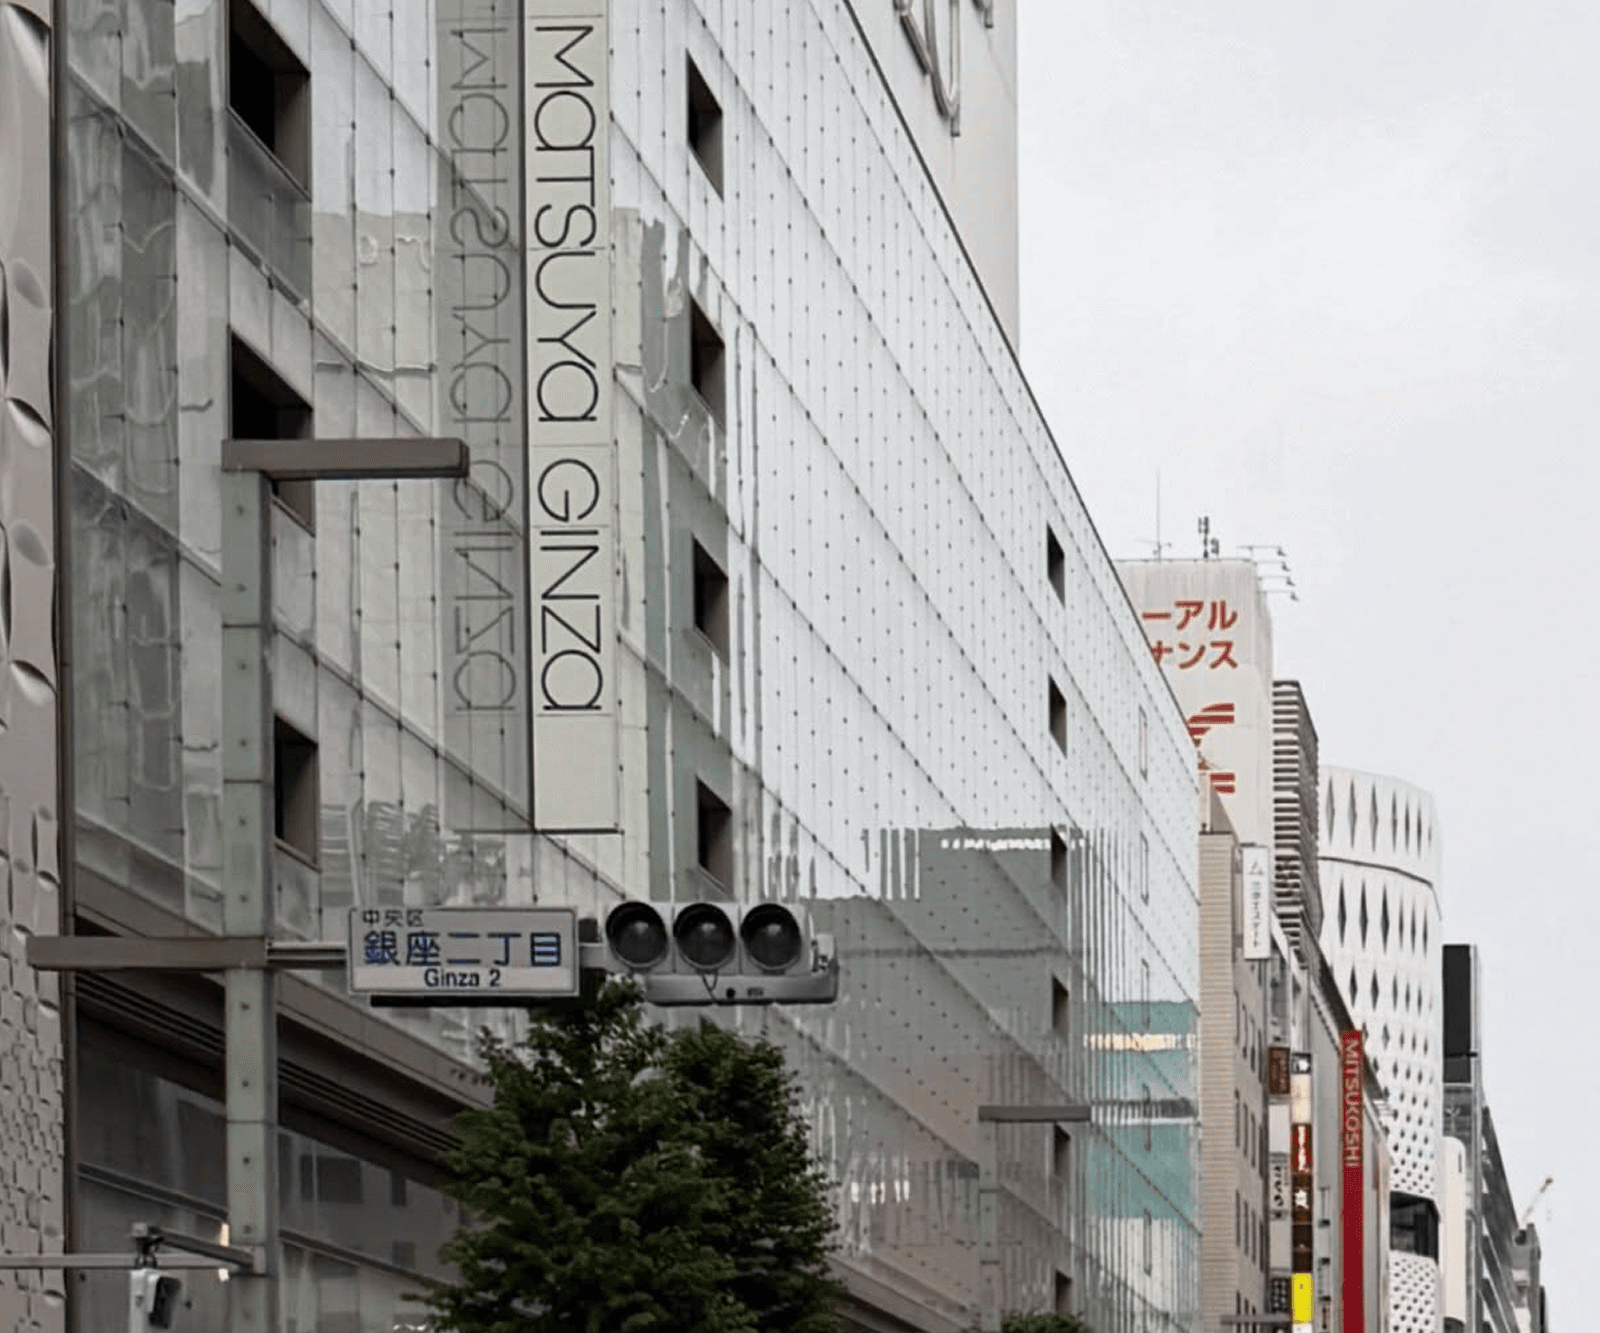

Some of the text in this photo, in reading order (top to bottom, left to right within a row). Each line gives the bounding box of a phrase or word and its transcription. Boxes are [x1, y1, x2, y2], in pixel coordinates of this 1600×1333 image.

[1142, 600, 1238, 630] ーアル
[362, 909, 424, 927] 中央区
[363, 930, 562, 967] 銀座二丁目
[424, 968, 502, 988] Ginza 2
[1346, 1038, 1360, 1168] MITSUKOSHI
